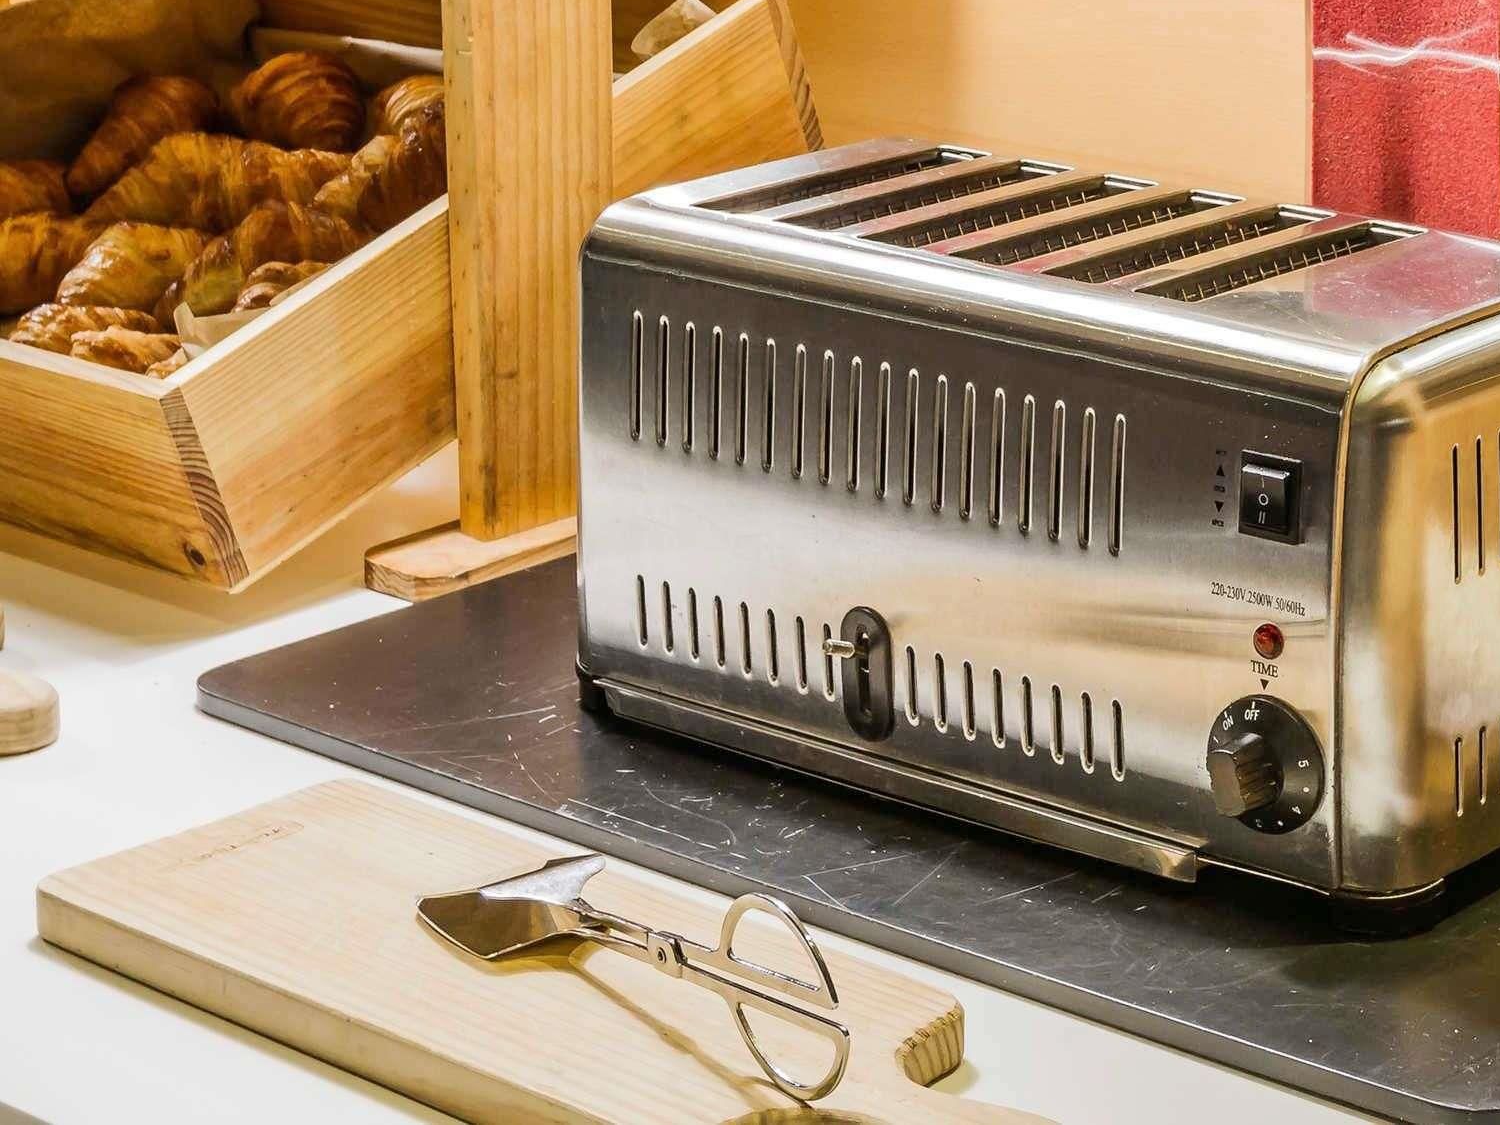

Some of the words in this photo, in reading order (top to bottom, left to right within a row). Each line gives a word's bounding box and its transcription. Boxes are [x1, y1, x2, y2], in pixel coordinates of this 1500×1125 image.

[1250, 659, 1279, 678] TIME
[1244, 709, 1260, 721] OFF
[1222, 716, 1234, 731] ON
